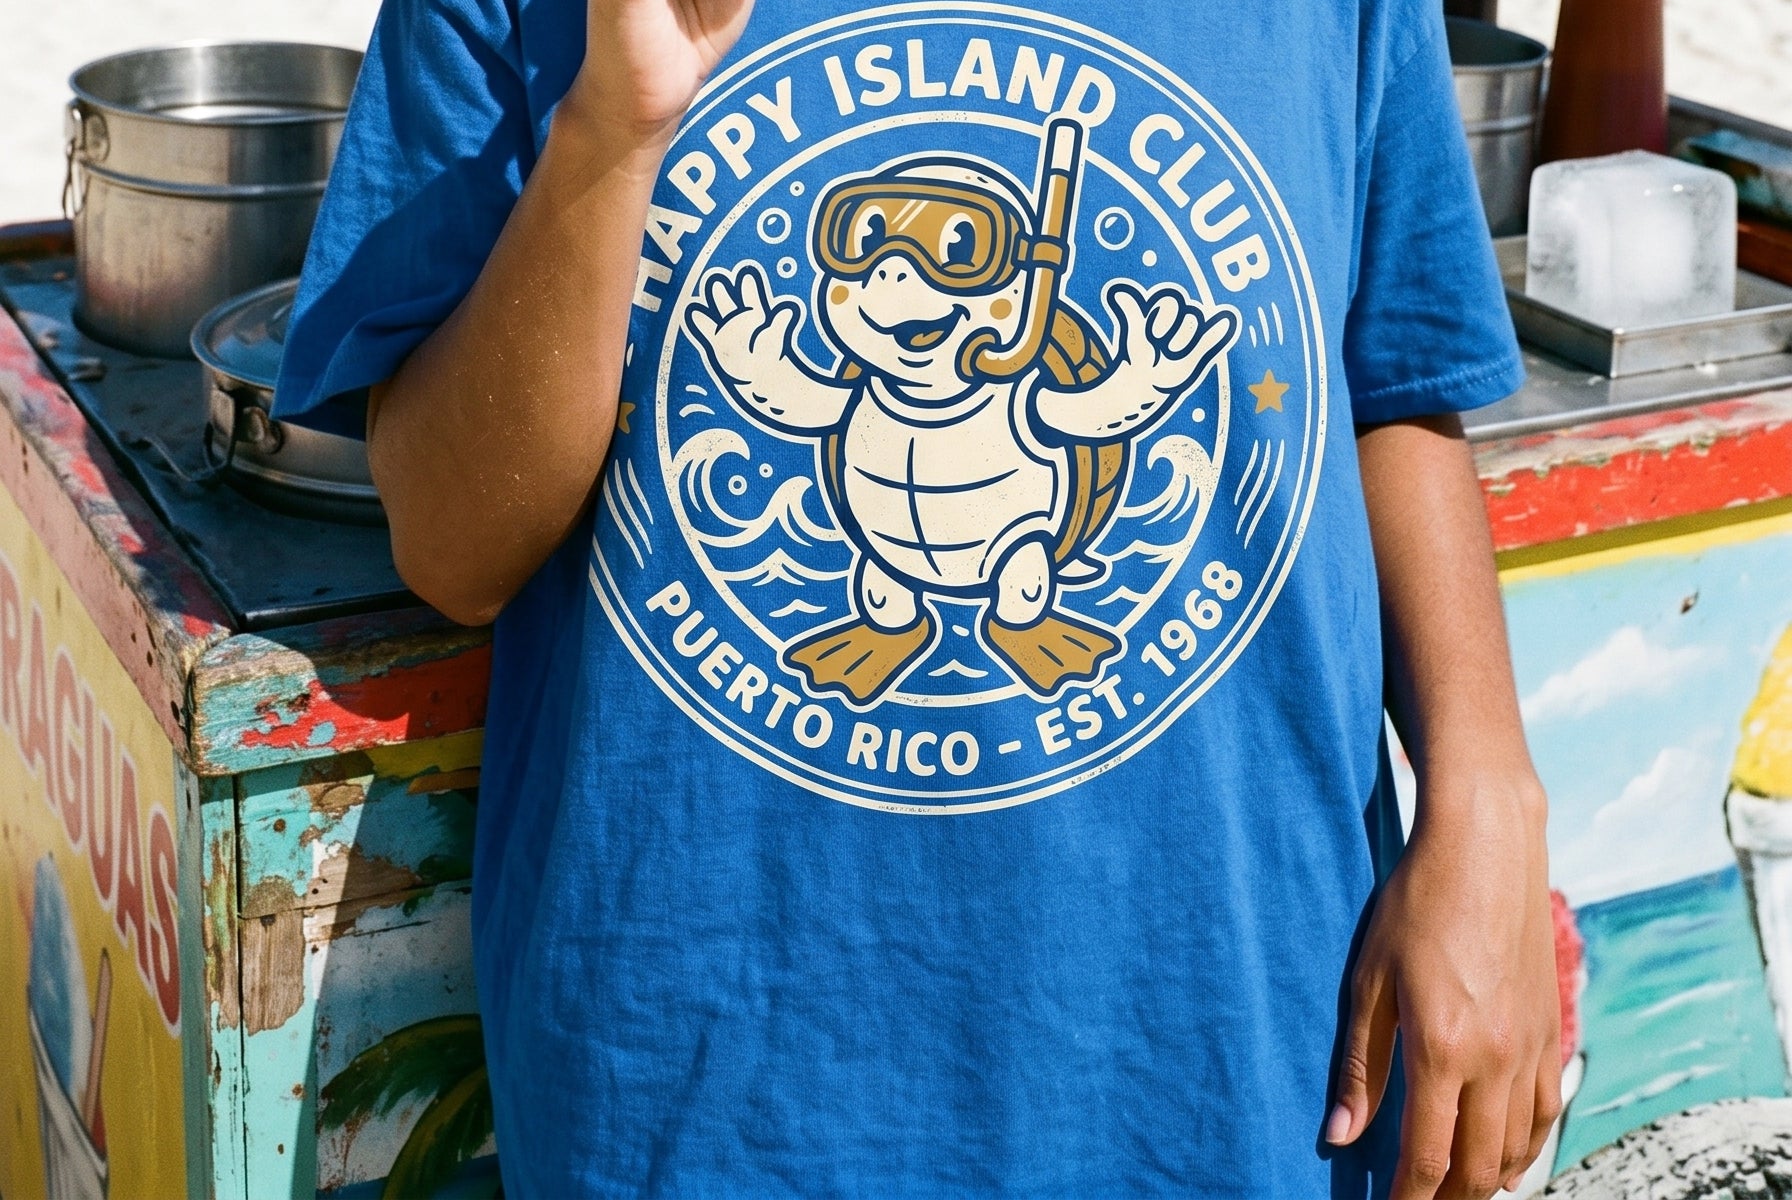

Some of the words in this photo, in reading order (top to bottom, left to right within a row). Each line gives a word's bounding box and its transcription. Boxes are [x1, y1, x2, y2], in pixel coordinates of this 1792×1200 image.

[632, 75, 802, 313] HAPPY
[824, 37, 1116, 128] ISLAND
[1129, 113, 1271, 293] CLUB
[645, 580, 834, 749] PUERTO
[846, 722, 980, 777] RICO
[1035, 674, 1146, 756] EST.
[1140, 560, 1243, 677] 1968
